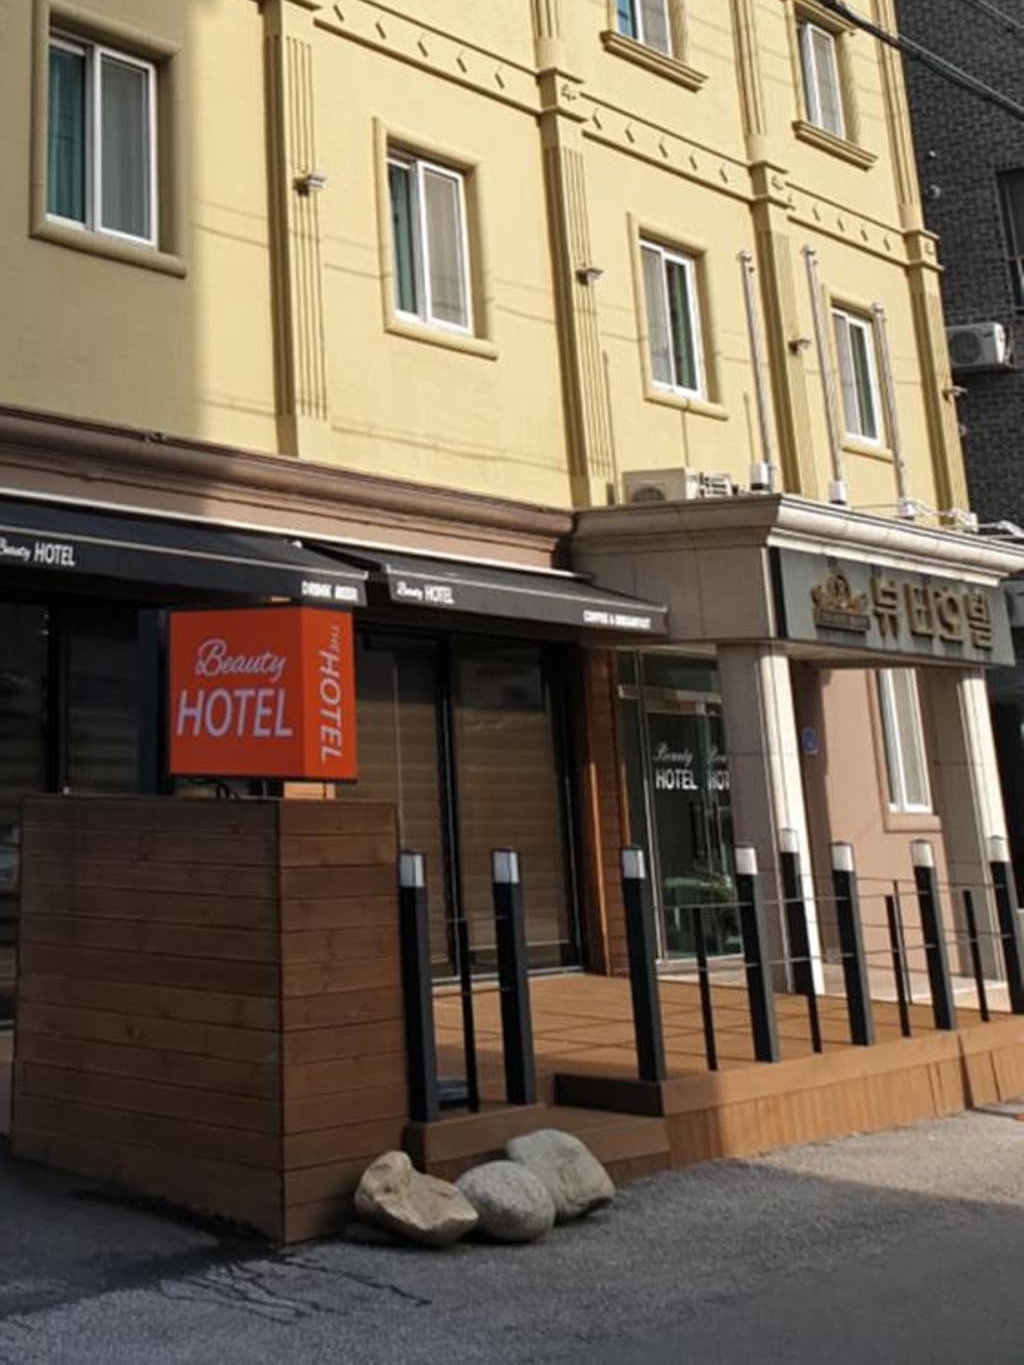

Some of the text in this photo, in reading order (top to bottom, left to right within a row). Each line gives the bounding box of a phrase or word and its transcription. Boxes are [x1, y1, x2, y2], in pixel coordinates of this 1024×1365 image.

[34, 541, 75, 567] HOTEL
[424, 585, 455, 604] HOTEL
[195, 638, 287, 683] Beauty
[176, 688, 293, 738] HOTEL
[317, 650, 343, 763] HOTEL
[655, 769, 698, 790] HOTEL
